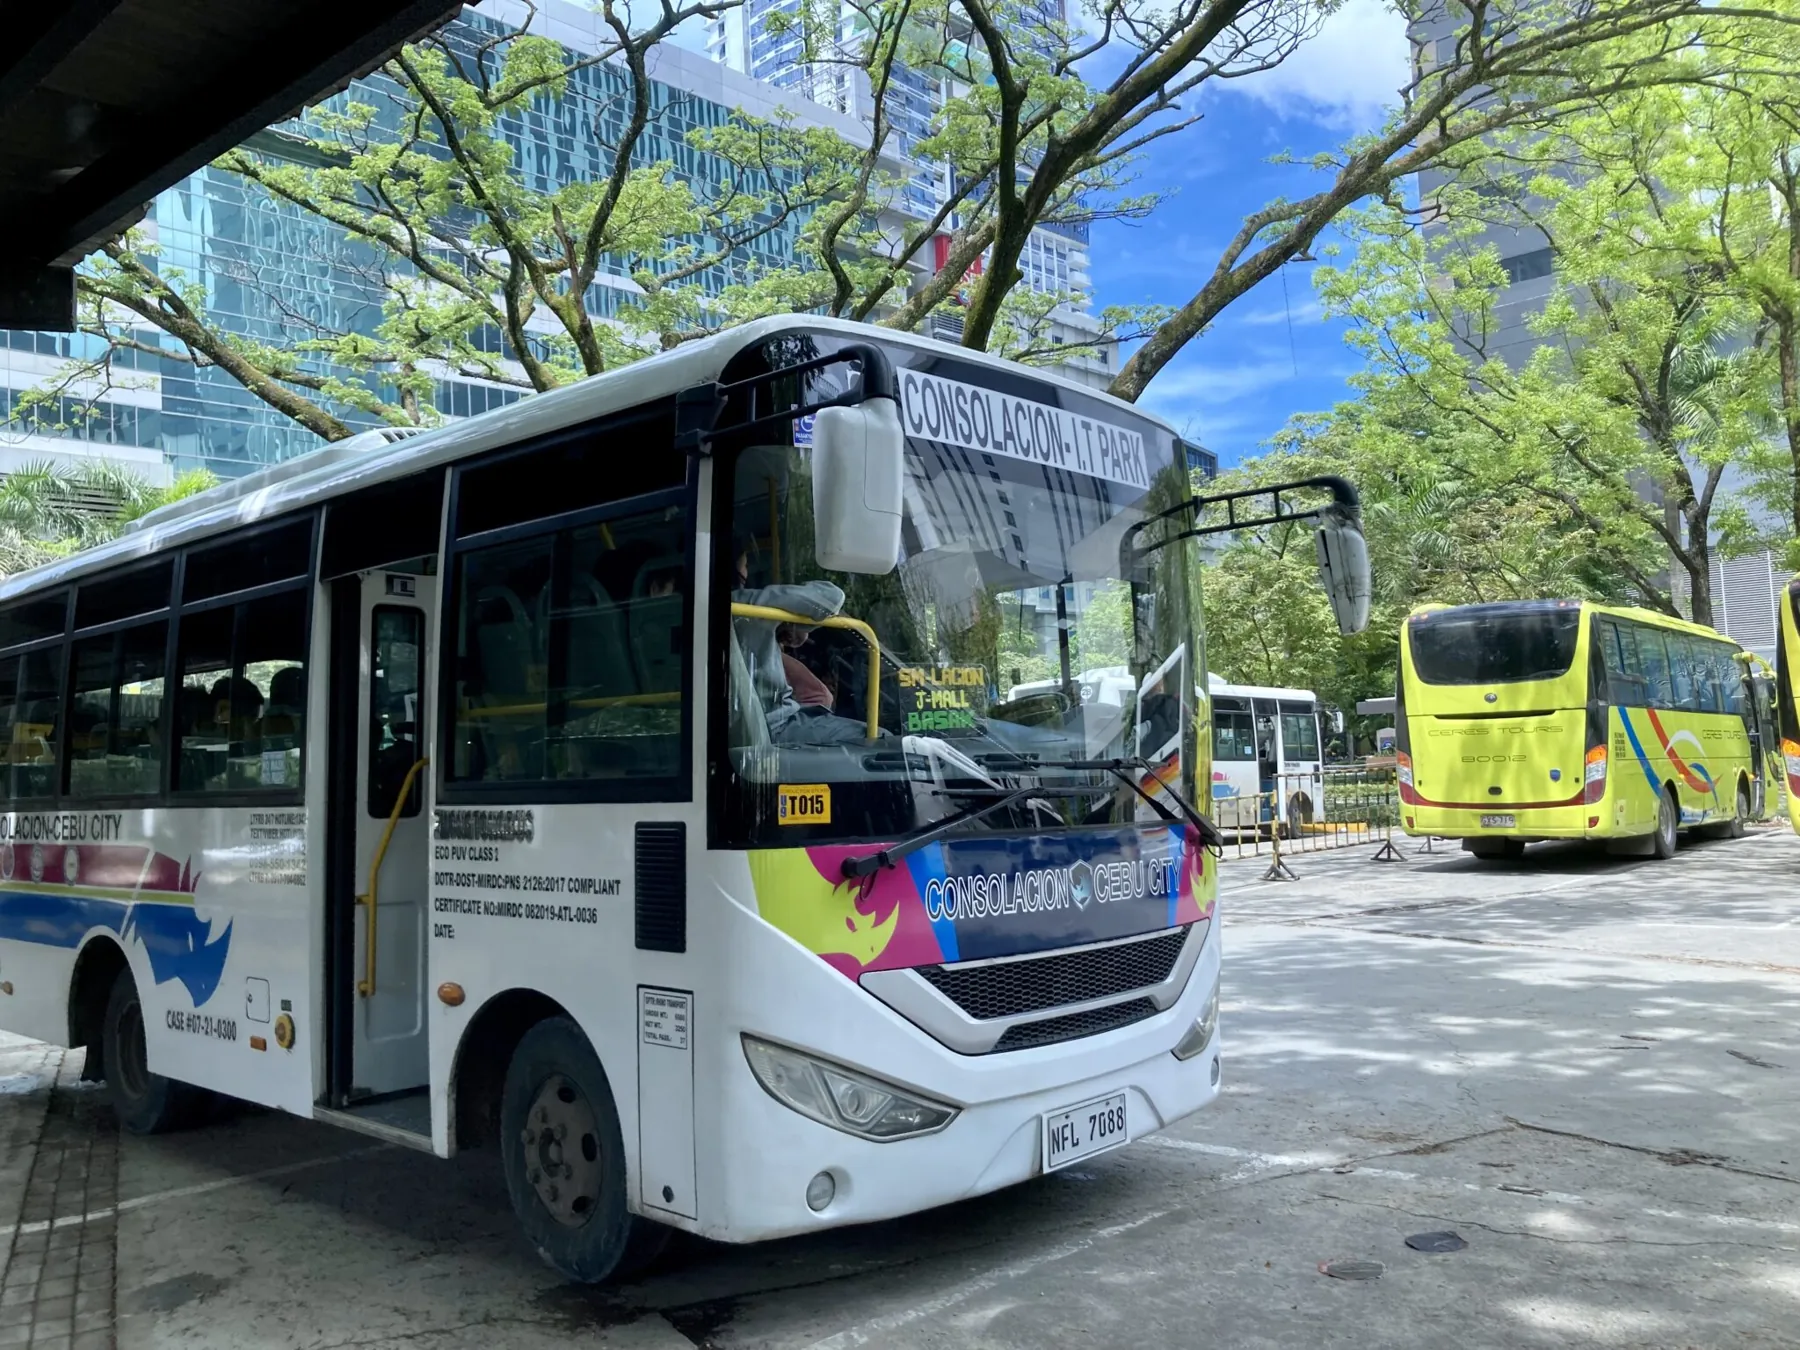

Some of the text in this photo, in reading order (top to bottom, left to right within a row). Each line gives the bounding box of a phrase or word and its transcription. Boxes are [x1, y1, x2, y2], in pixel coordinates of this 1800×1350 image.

[1097, 425, 1147, 486] PARK
[899, 667, 984, 687] SM-LACION
[915, 690, 970, 710] J-MALL
[1428, 725, 1564, 737] CERES TOURS
[788, 794, 824, 816] T015
[91, 814, 122, 841] CITY
[435, 845, 450, 860] ECO
[451, 846, 468, 861] PUV
[468, 846, 494, 862] CLASS
[522, 876, 565, 893] 2126:2017
[567, 877, 621, 896] COMPLIANT
[925, 855, 1182, 922] CONSOLACION CEBU CITY
[434, 897, 482, 915] CERTIFICATE
[434, 923, 455, 939] DATE:
[167, 1009, 237, 1041] CASE #07-21-0300
[1051, 1105, 1124, 1155] NFL 7088
